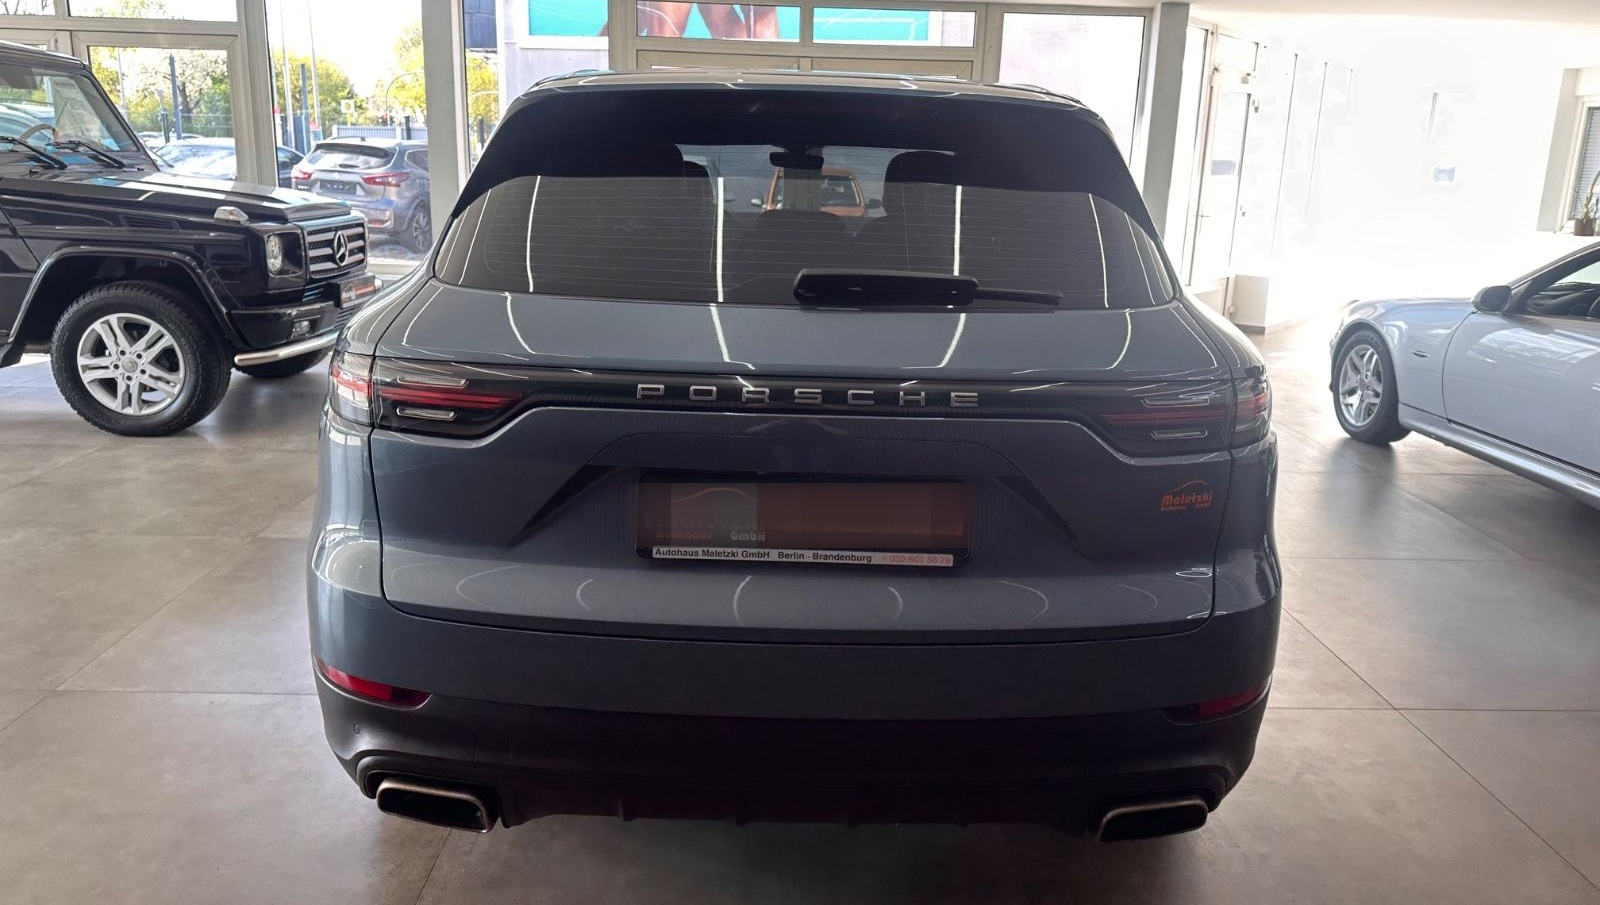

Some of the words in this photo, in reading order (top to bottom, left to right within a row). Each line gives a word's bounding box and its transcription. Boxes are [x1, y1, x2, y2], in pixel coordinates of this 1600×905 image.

[637, 383, 979, 407] PORSCHE
[656, 529, 713, 540] Autohaus
[730, 530, 766, 542] GmbH
[655, 548, 699, 558] Autohaus
[701, 549, 739, 559] Maletzki
[741, 550, 770, 560] GmbH
[777, 551, 805, 560] Berlin
[812, 552, 872, 564] Brandenburg
